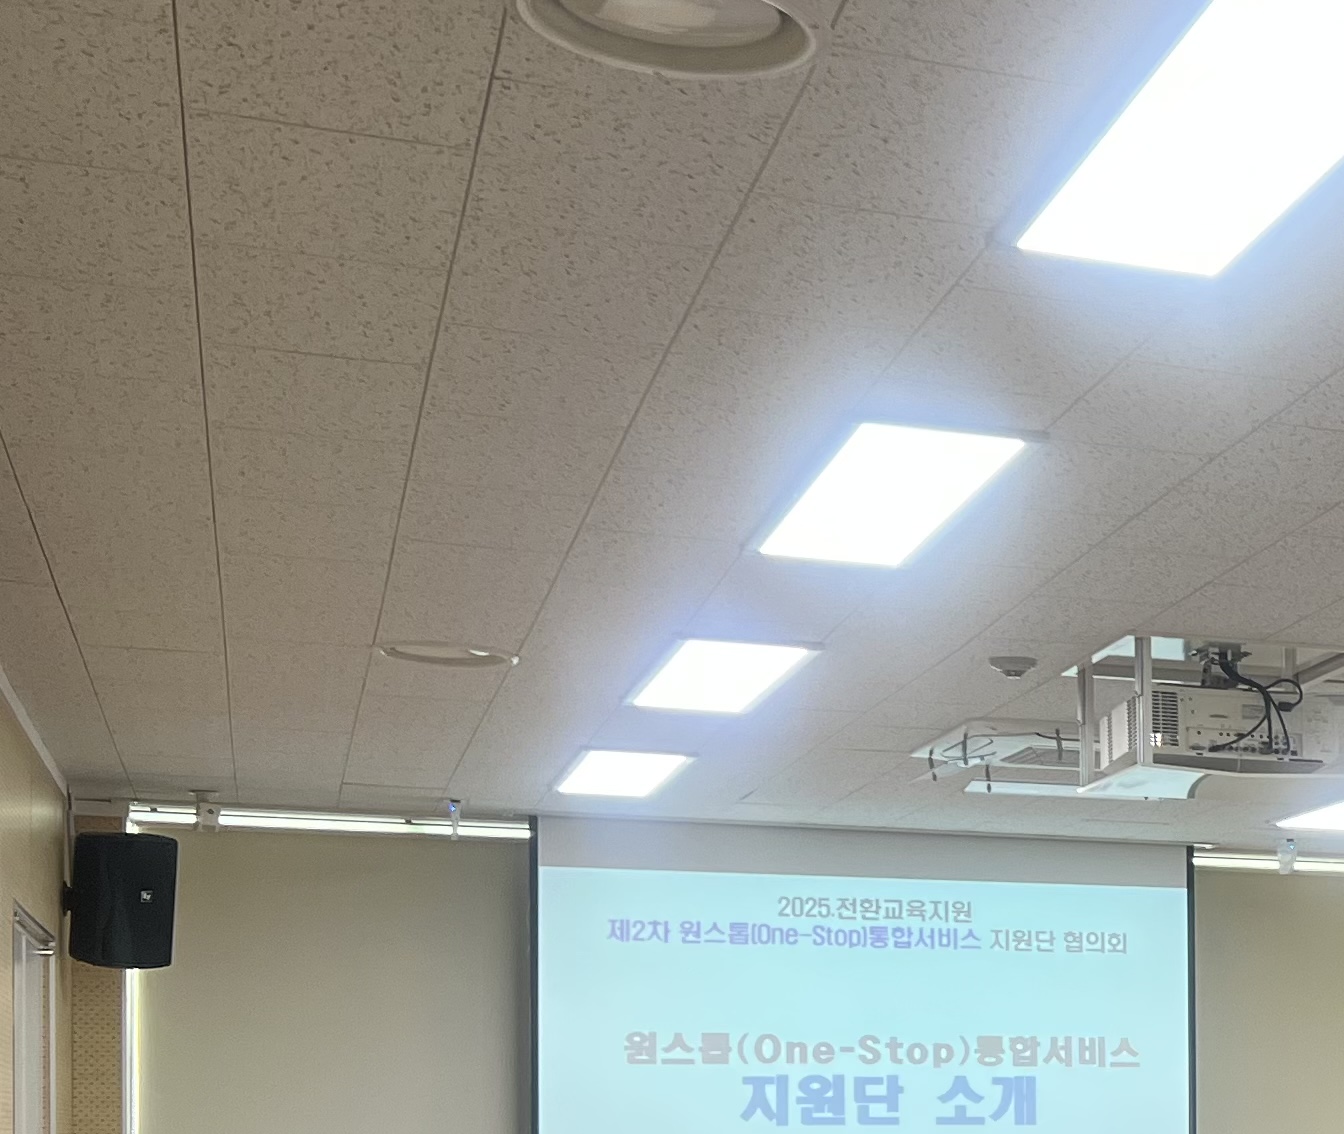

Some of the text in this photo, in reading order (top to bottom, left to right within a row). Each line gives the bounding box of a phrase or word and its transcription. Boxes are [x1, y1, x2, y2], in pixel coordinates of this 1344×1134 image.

[607, 919, 671, 944] 제2차
[989, 930, 1055, 953] 지원단
[1062, 931, 1128, 955] 협의회
[740, 1074, 1037, 1126] 지원단 소개
